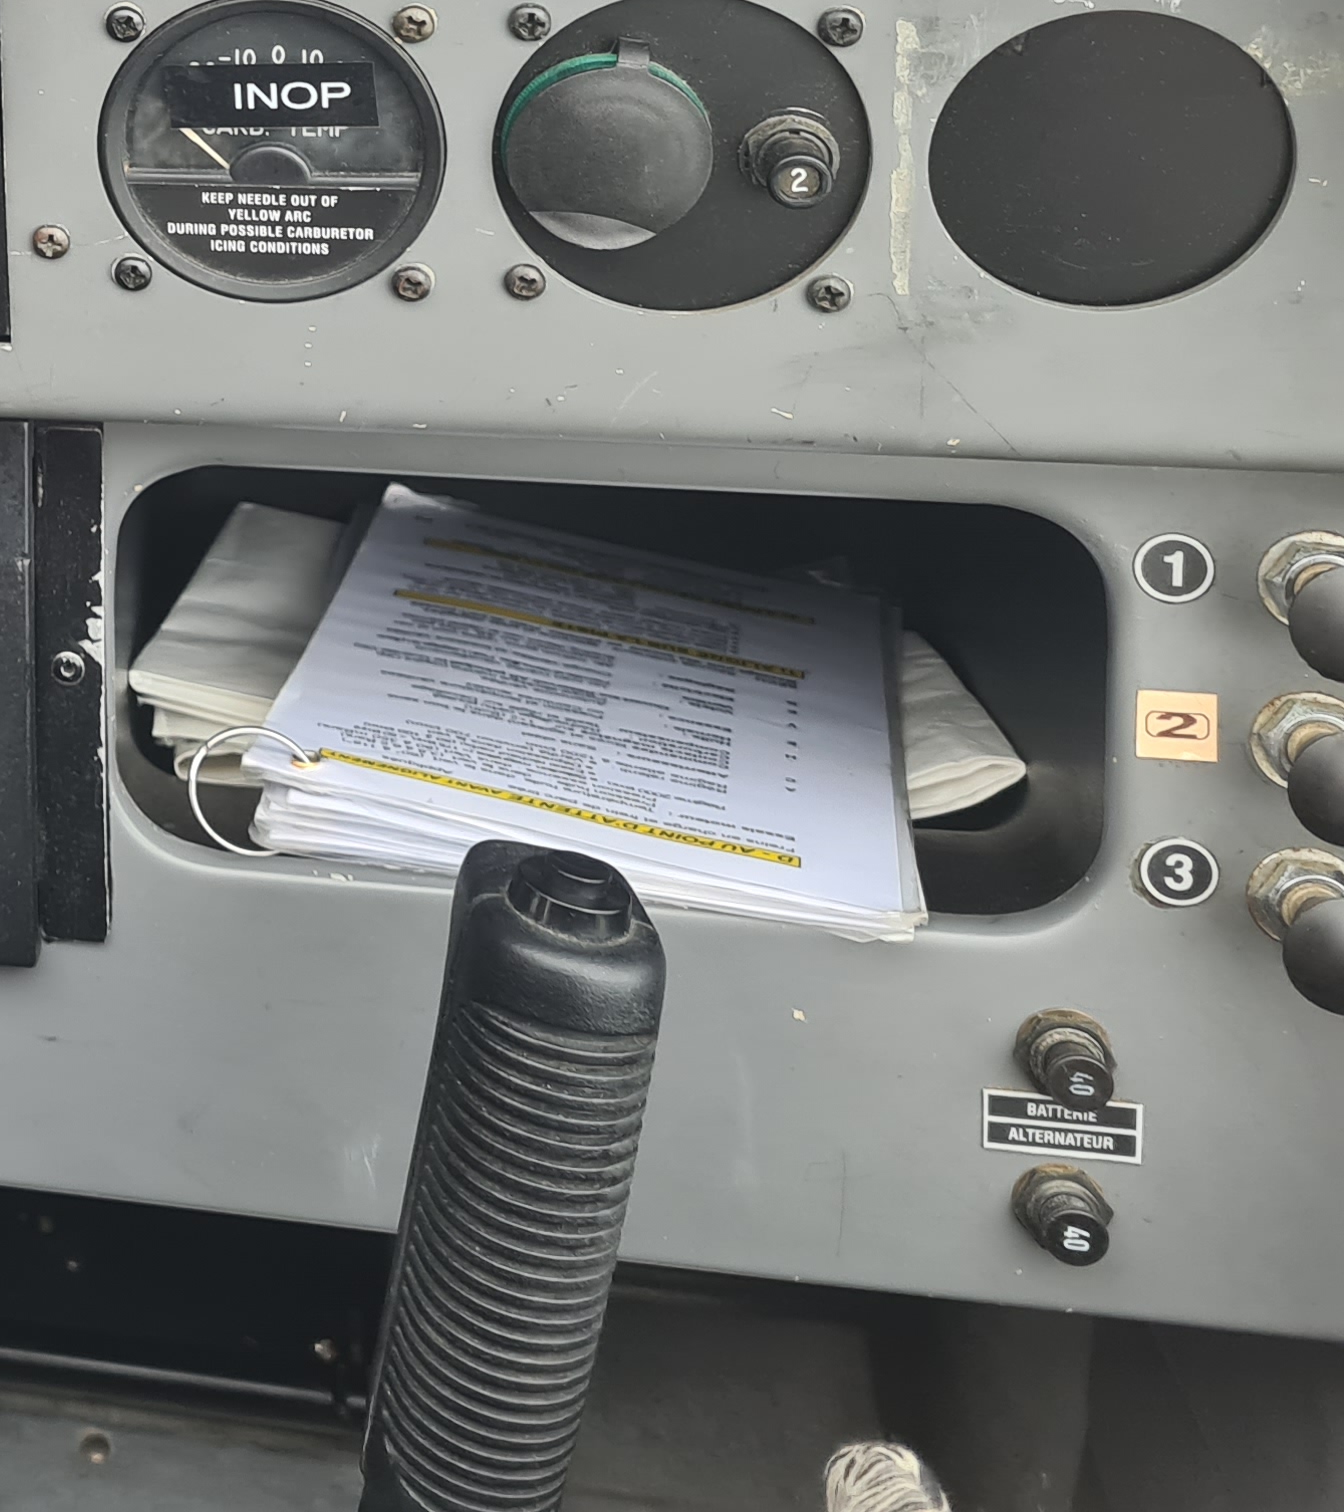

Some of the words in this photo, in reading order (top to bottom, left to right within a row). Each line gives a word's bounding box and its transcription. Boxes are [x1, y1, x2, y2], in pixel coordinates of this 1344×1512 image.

[234, 81, 352, 110] INOP
[790, 167, 809, 194] 2
[202, 192, 234, 205] KEEP
[238, 192, 287, 206] NEEDLE
[291, 194, 318, 207] OUT
[320, 195, 339, 208] OF
[228, 208, 281, 222] YELLOW
[284, 210, 312, 223] ARC
[167, 222, 217, 236] DURING
[220, 224, 284, 238] POSSIBLE
[287, 226, 374, 241] CARBURETOR
[210, 239, 246, 253] ICING
[249, 240, 330, 256] CONDITIONS
[1163, 551, 1185, 587] 1
[1155, 713, 1197, 738] 2
[1164, 854, 1193, 888] 3
[1007, 1125, 1115, 1152] ALTERNATEUR
